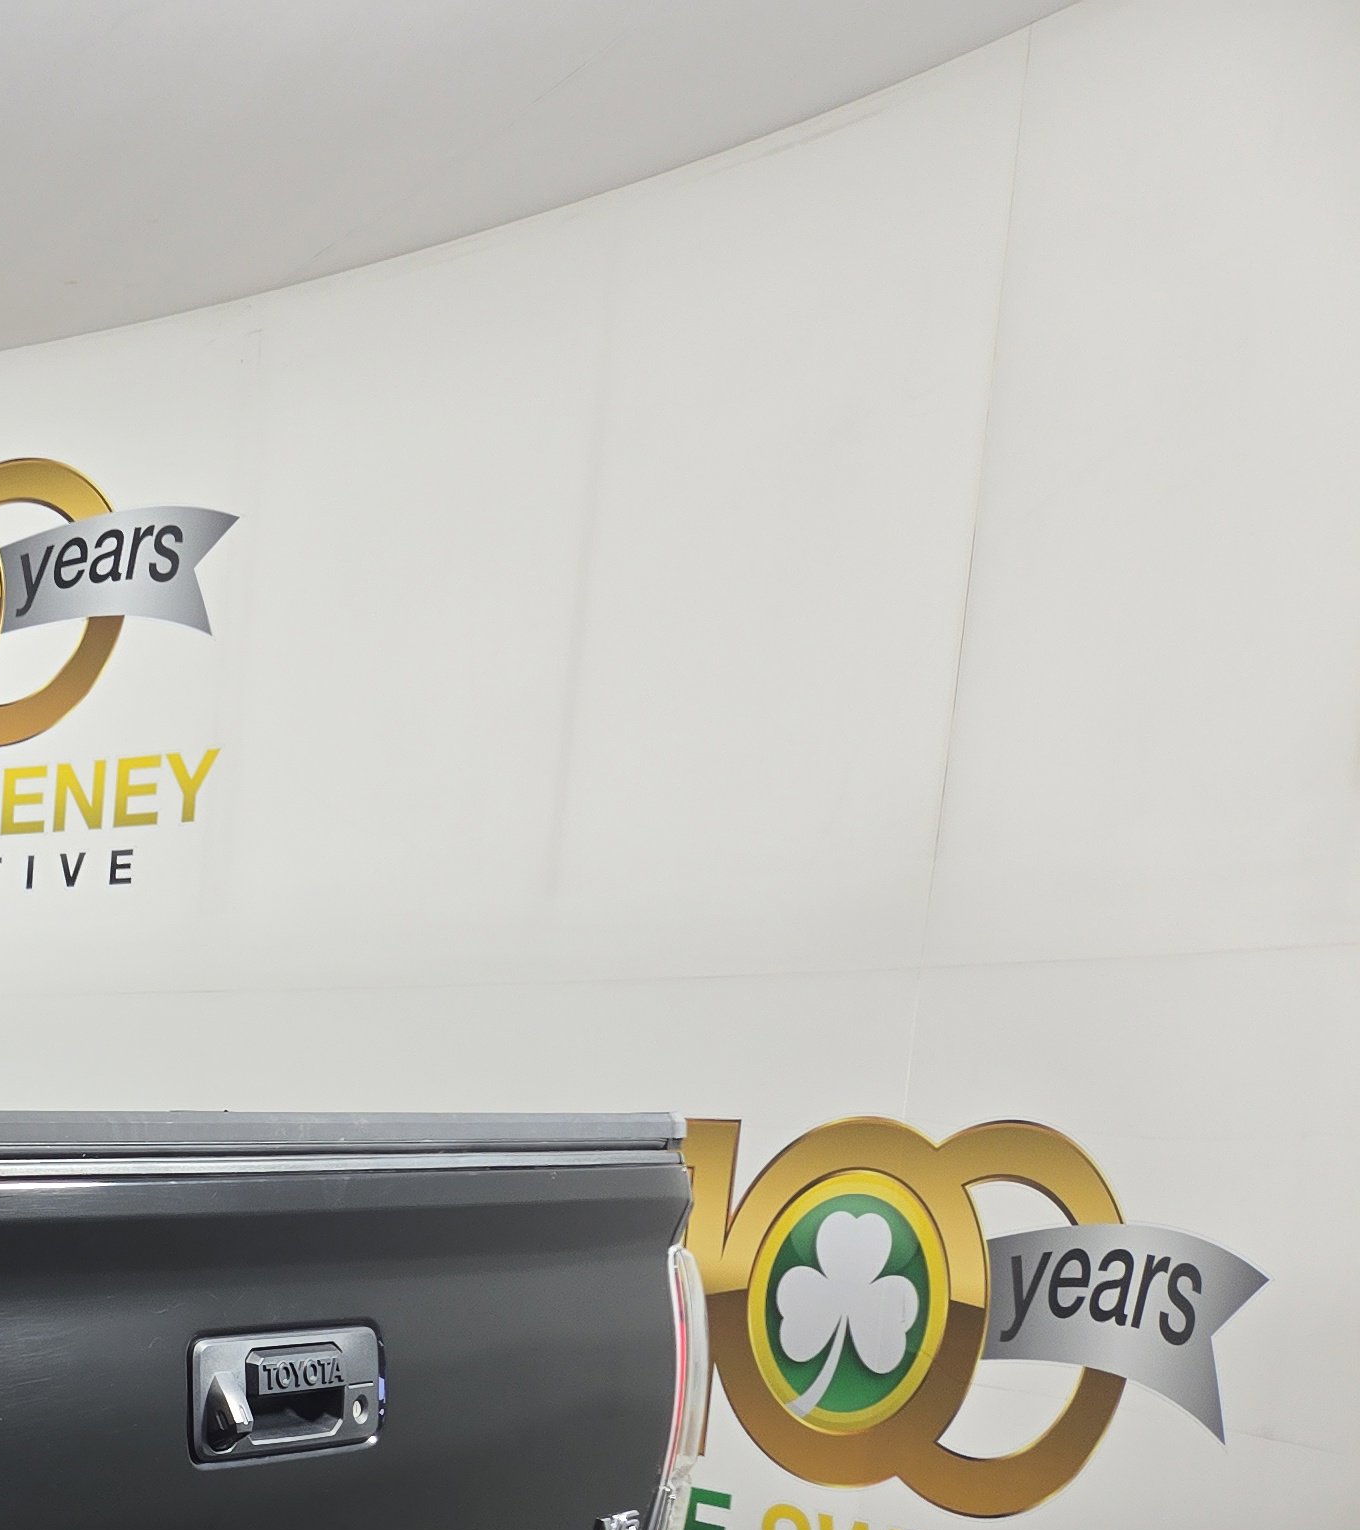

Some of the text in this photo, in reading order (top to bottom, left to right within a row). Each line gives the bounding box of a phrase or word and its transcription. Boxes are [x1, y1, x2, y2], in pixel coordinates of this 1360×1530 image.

[16, 523, 183, 617] years
[999, 1247, 1203, 1347] years
[263, 1357, 345, 1390] TOYOTA
